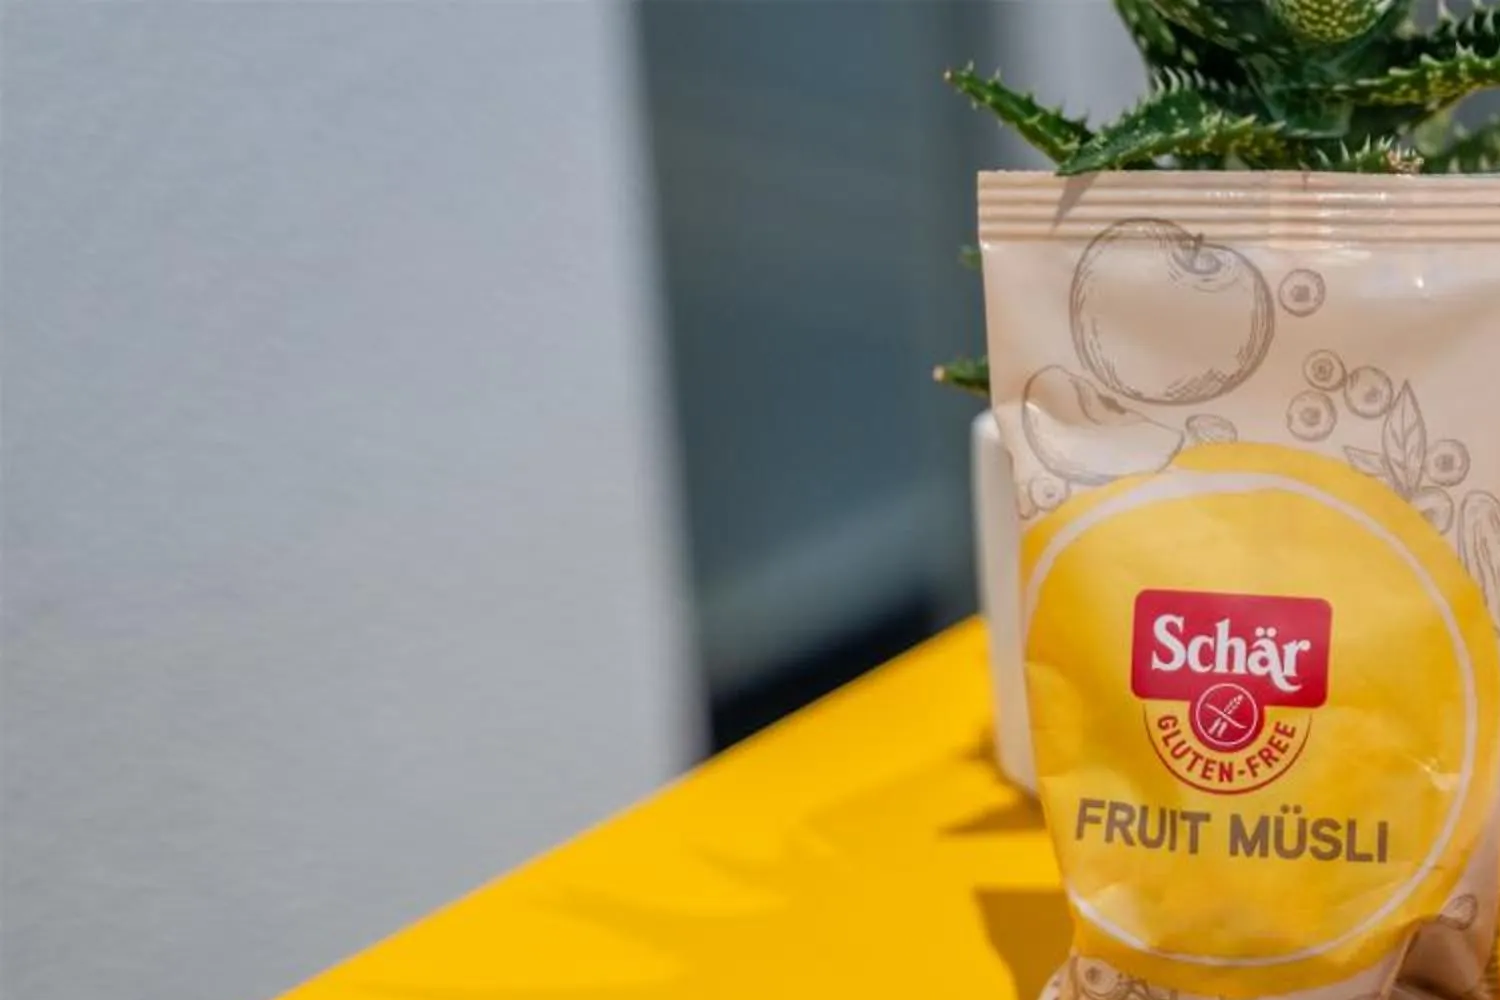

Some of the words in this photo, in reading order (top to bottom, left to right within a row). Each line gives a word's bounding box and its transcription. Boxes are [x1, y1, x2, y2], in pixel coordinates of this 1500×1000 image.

[1151, 613, 1312, 692] Schär
[1156, 714, 1296, 783] GLUTEN-FREE
[1075, 797, 1211, 854] FRUIT
[1228, 805, 1390, 863] MÜSLI
